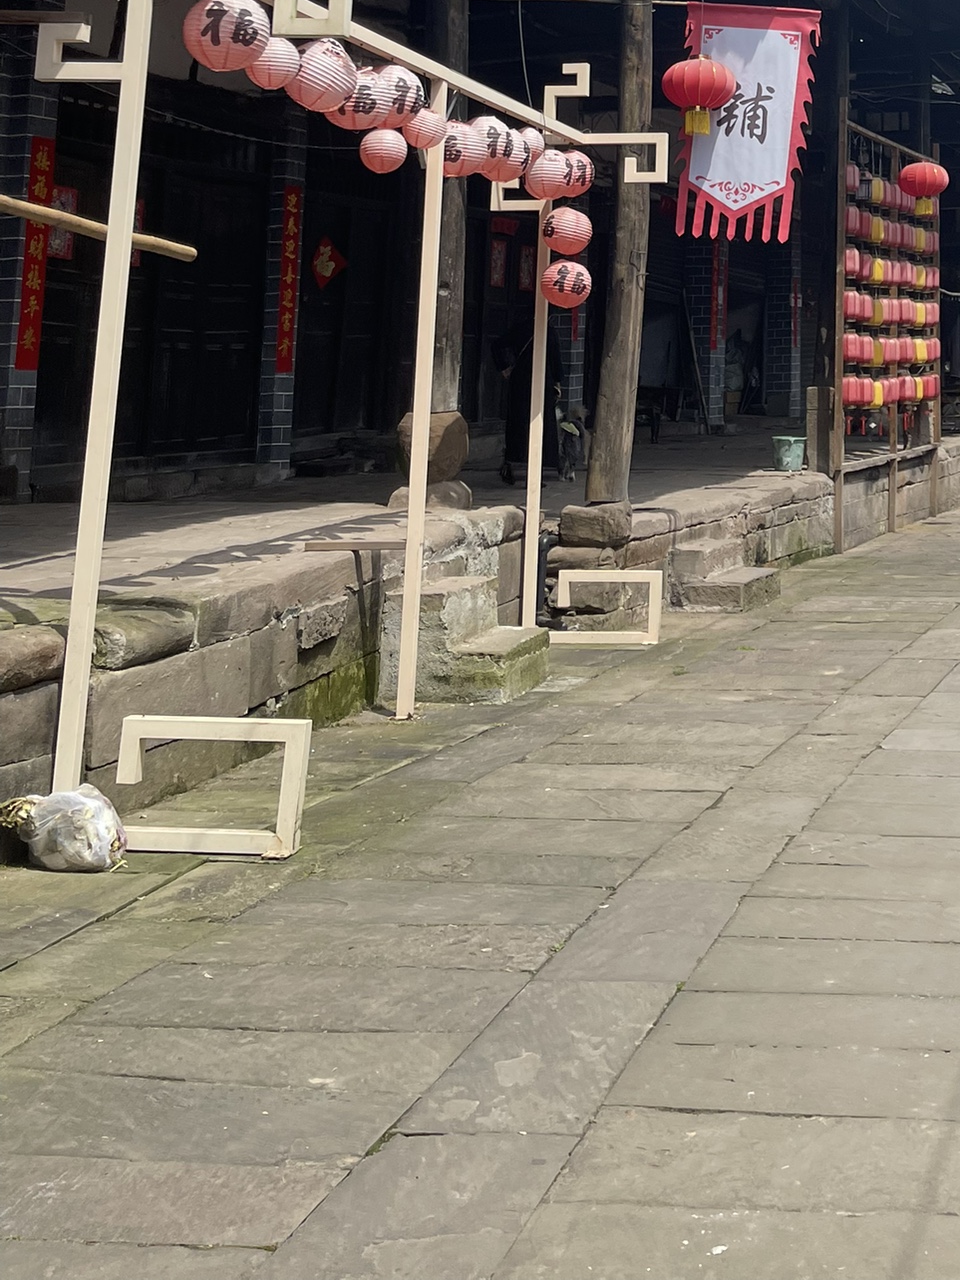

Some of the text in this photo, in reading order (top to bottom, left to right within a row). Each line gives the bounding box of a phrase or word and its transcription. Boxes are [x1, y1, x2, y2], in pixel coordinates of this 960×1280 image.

[201, 1, 258, 47] 福
[713, 81, 776, 145] 铺
[553, 265, 586, 296] 福
